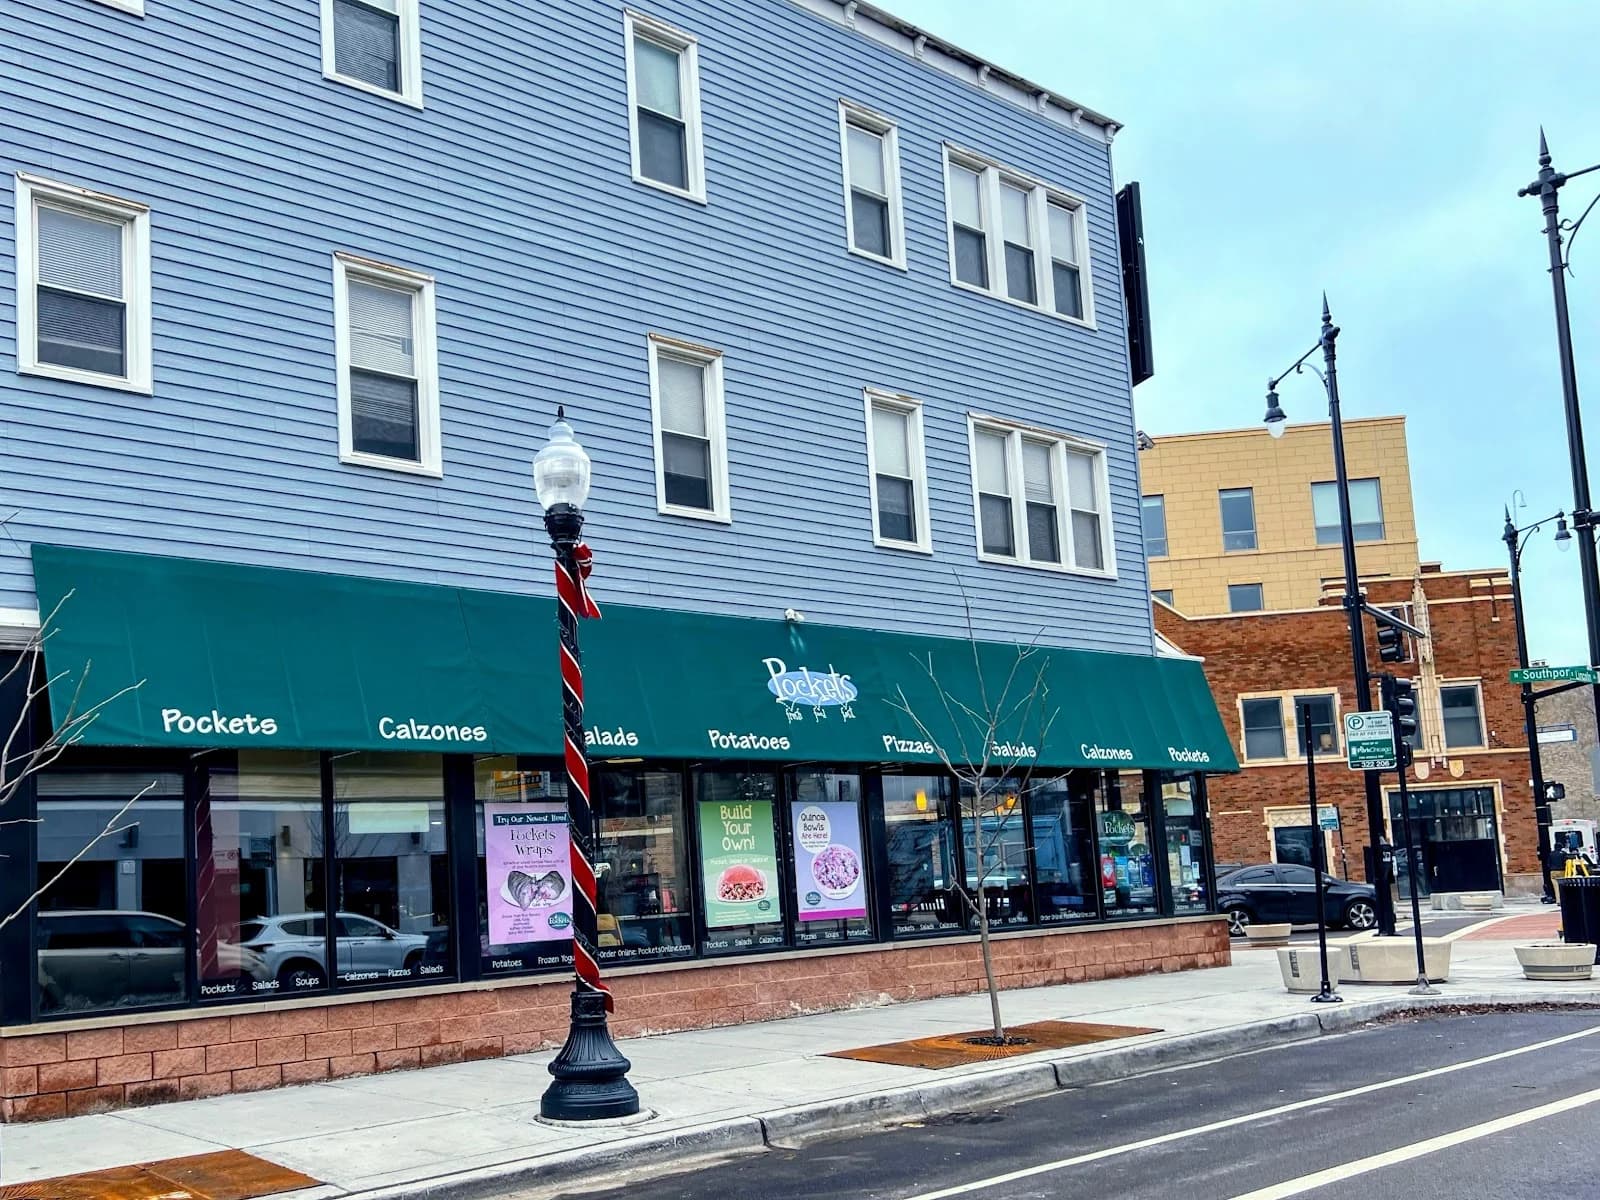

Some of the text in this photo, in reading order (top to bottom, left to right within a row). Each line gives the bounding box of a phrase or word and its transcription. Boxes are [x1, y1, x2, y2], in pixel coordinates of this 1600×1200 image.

[762, 657, 857, 703] Pockets
[1523, 669, 1570, 680] Southpor
[161, 708, 278, 735] Pockets
[378, 717, 487, 742] Calzones
[584, 726, 639, 747] alads
[708, 729, 790, 750] Potatoes
[882, 735, 934, 754] Pizzas
[991, 740, 1037, 758] Salads
[1081, 743, 1134, 760] Calzones
[1167, 747, 1210, 763] Pockets
[720, 804, 752, 819] Build
[801, 813, 826, 821] Quinoa
[511, 827, 556, 840] Pockets
[722, 821, 752, 835] Your
[803, 823, 824, 831] Bowls
[1105, 820, 1135, 834] Pockets
[515, 844, 553, 858] Wraps
[722, 835, 755, 851] Own!
[706, 940, 729, 949] Pockets
[735, 937, 753, 946] Salads
[492, 954, 575, 969] Potatoes Frozen Yogu
[600, 949, 617, 958] Order
[344, 964, 444, 981] Calzones Pizzas Salads
[201, 977, 319, 995] Pockets Salads Soups
